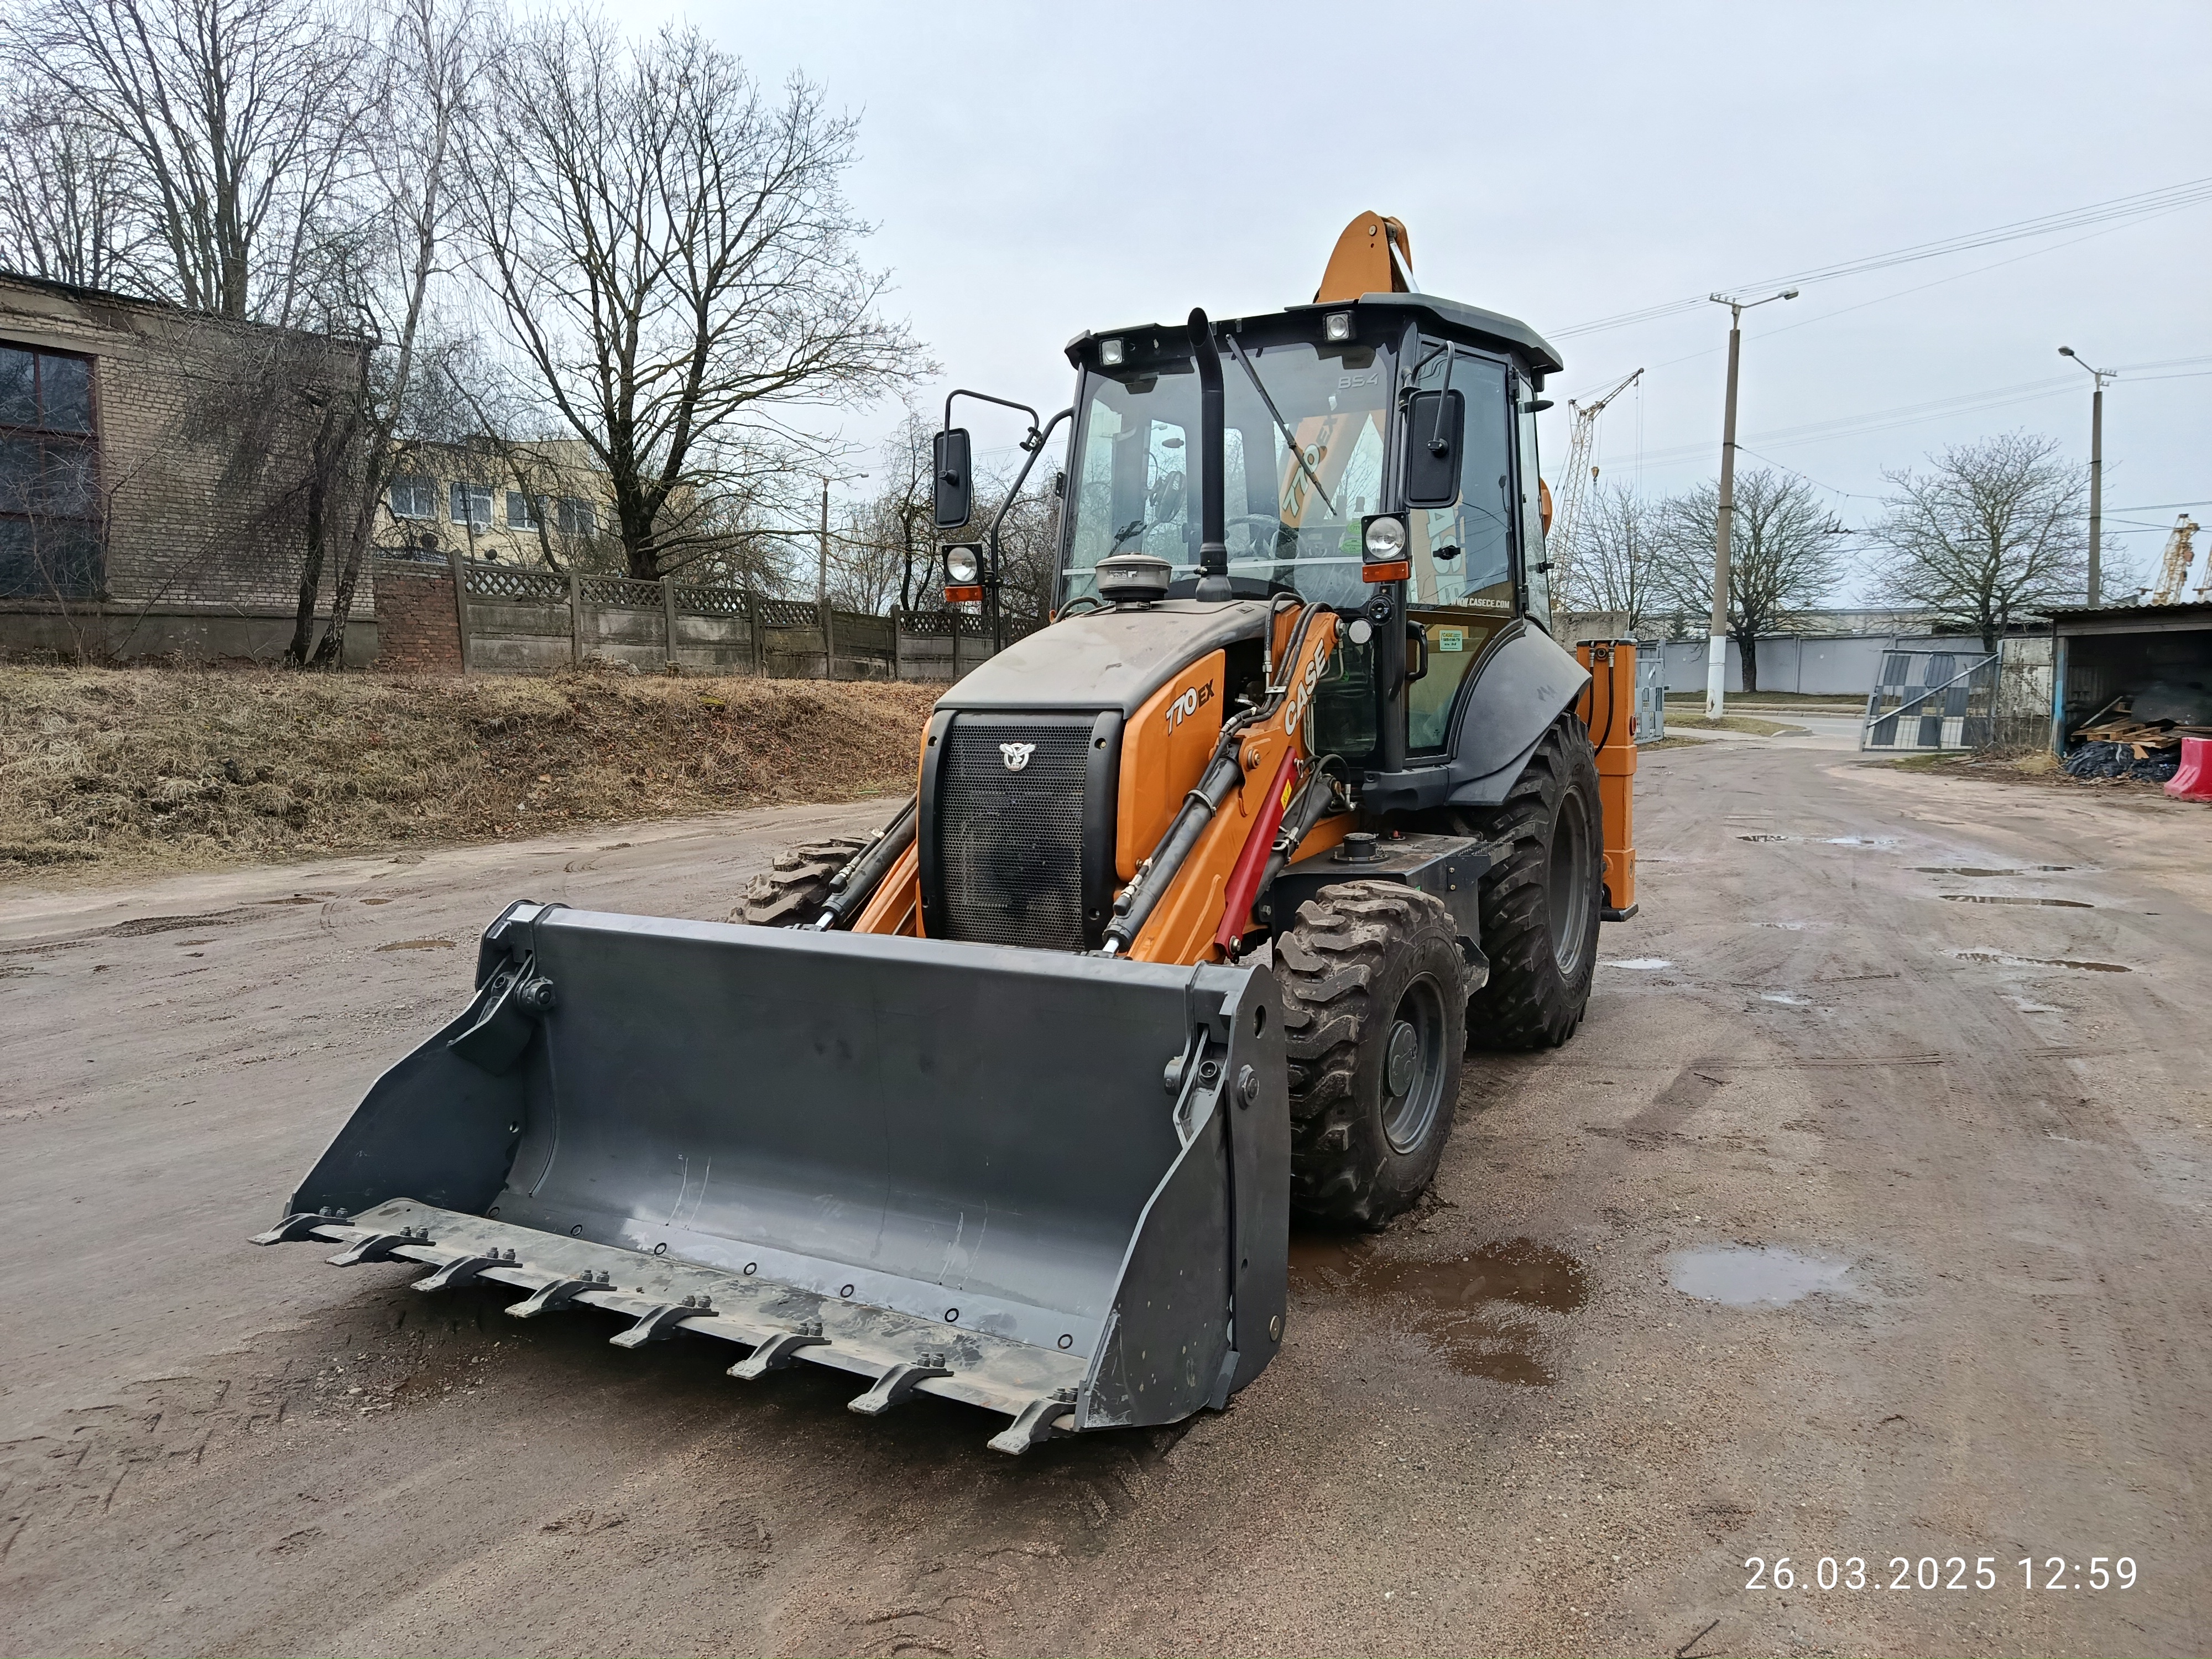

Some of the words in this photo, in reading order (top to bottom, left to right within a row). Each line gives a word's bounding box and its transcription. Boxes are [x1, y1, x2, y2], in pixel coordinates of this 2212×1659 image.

[1338, 373, 1379, 389] BS4
[1427, 507, 1467, 606] ASE
[1451, 597, 1510, 609] WWW.CASECE.COM
[1165, 686, 1198, 737] 770
[1198, 679, 1215, 708] EX
[1284, 638, 1326, 736] CASE
